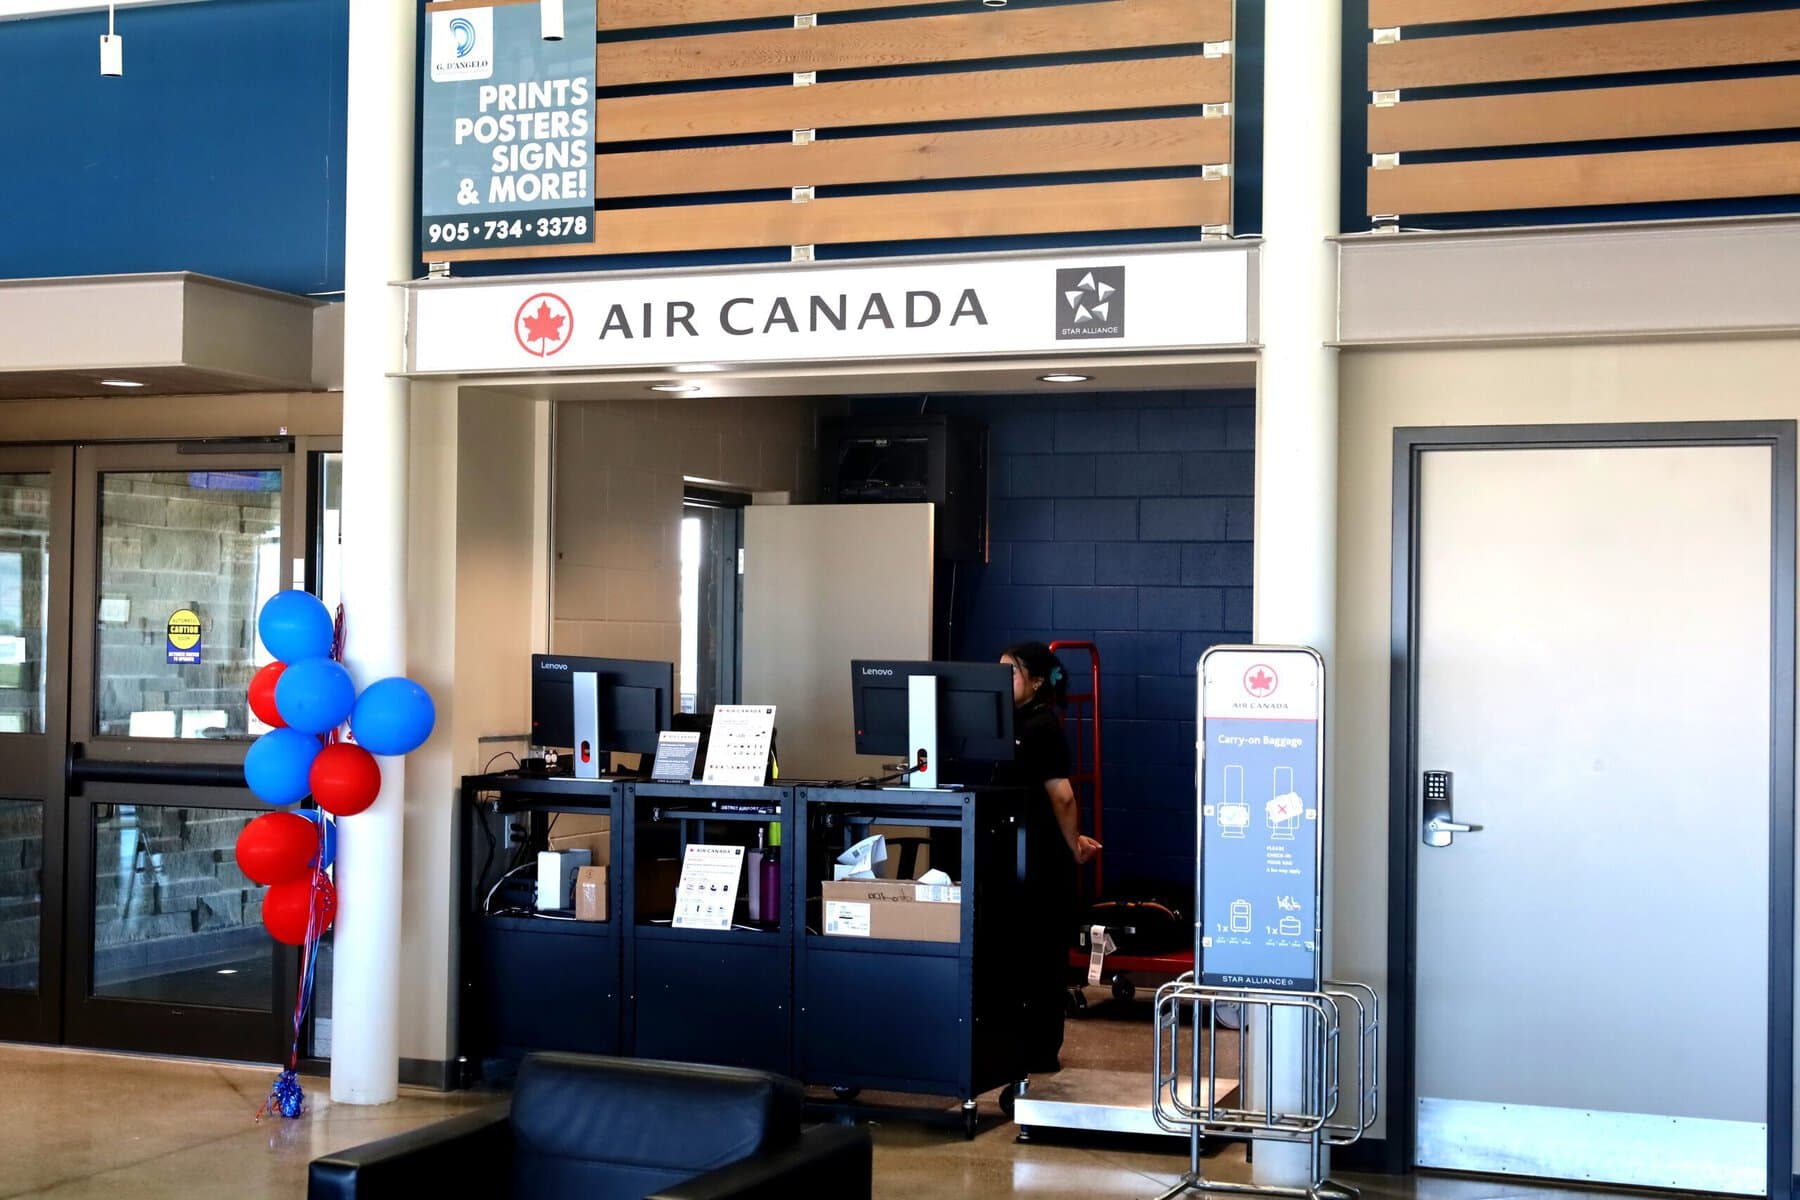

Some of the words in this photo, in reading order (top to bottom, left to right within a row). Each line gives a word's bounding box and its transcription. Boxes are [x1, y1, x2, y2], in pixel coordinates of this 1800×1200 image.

[479, 77, 589, 113] PRINTS
[455, 108, 589, 145] POSTERS
[491, 139, 588, 173] SIGNS
[456, 177, 480, 206] &
[488, 169, 587, 204] MORE!
[598, 301, 700, 340] AIR
[718, 288, 989, 336] CANADA
[1061, 327, 1081, 335] STAR
[1082, 326, 1119, 334] ALLIANCE
[170, 625, 199, 634] CAUTION
[541, 661, 568, 670] Lenovo
[862, 666, 893, 676] Lenovo
[1218, 734, 1261, 748] Carry-on
[1263, 735, 1303, 748] Baggage
[1222, 975, 1244, 983] STAR
[1245, 976, 1287, 986] ALLIANCE
